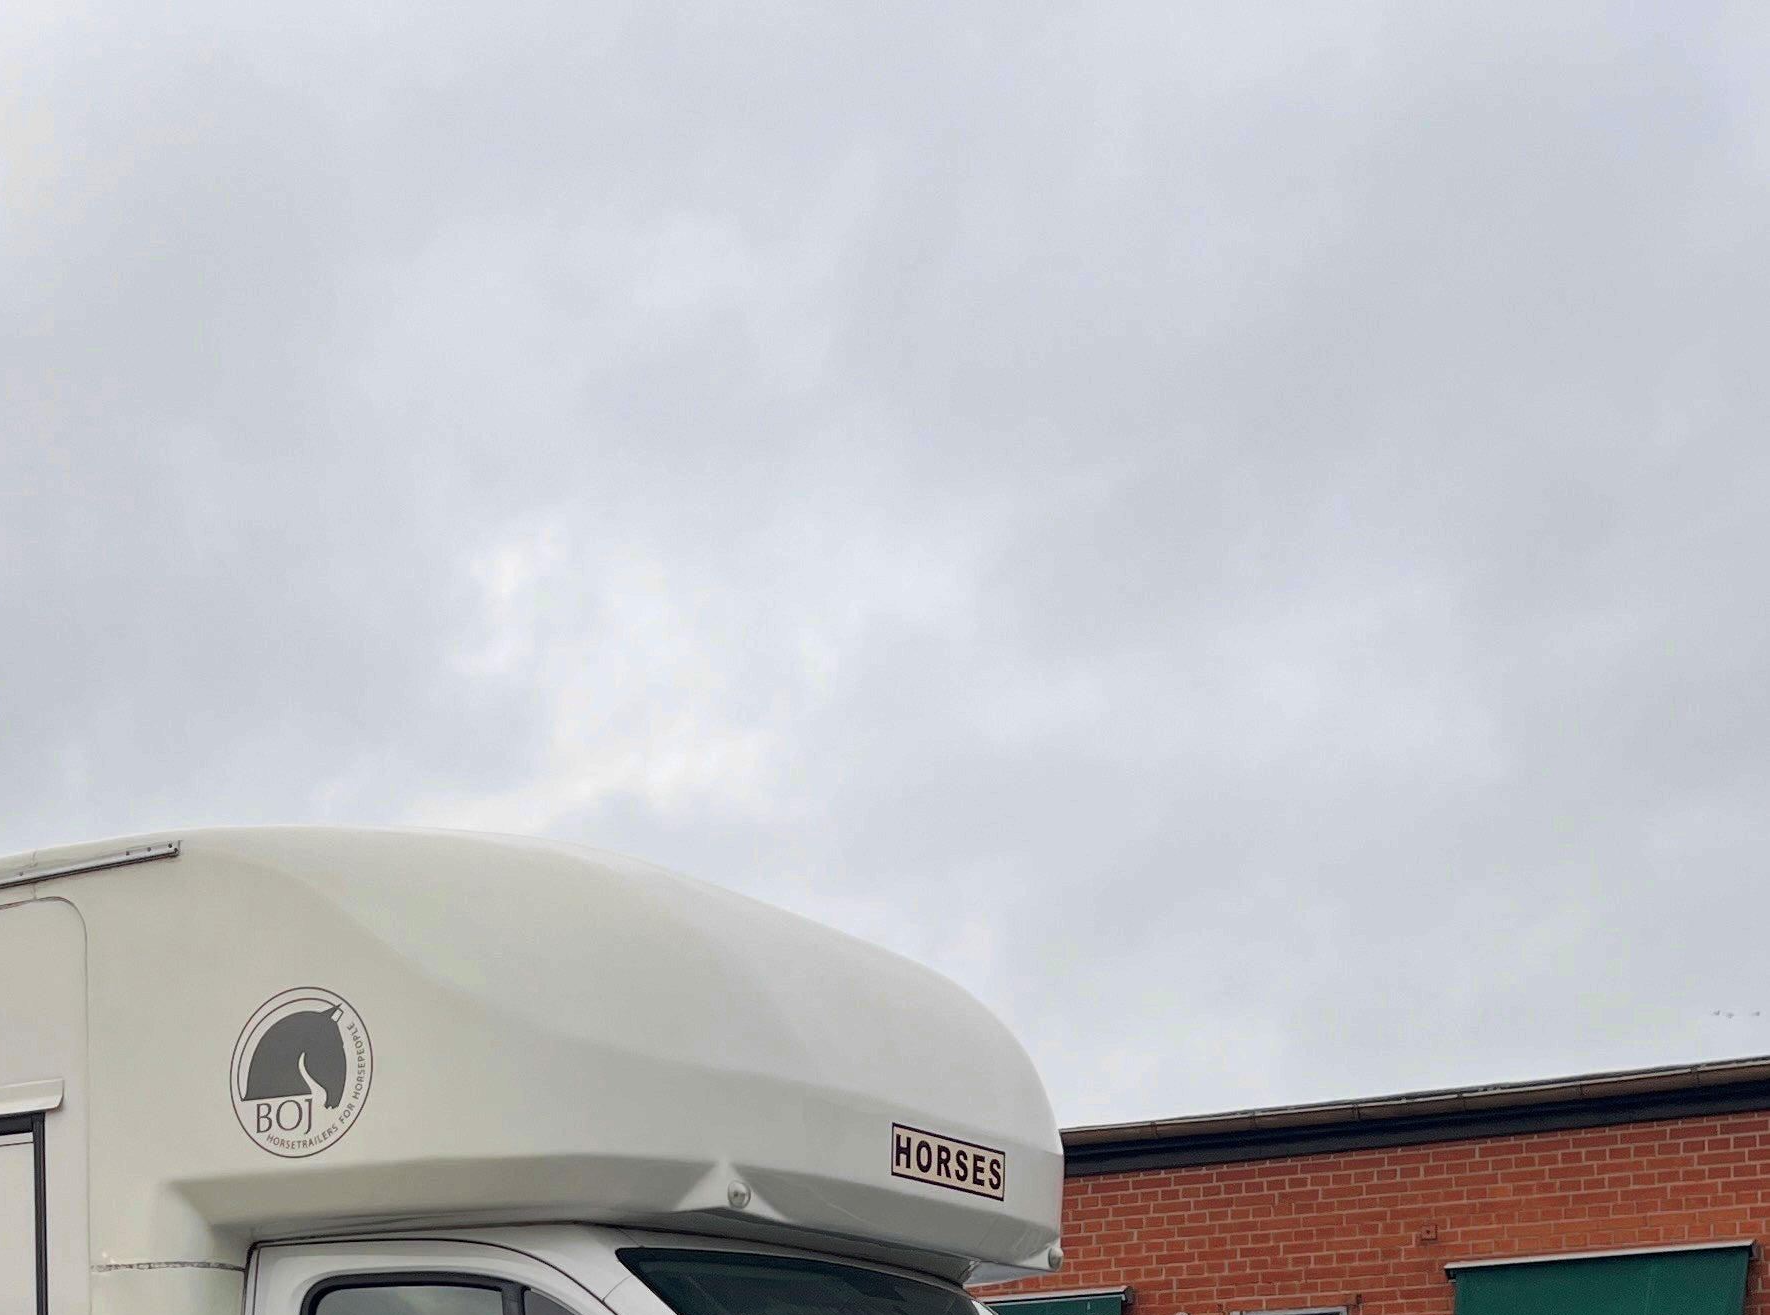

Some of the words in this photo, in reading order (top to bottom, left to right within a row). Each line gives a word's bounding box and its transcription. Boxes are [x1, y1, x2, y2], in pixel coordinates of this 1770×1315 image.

[346, 1021, 366, 1100] HORSEPEOPLE
[256, 1098, 314, 1135] BOJ
[338, 1103, 356, 1125] FOR
[265, 1124, 339, 1150] HORSETRAILERS
[895, 1133, 1002, 1190] HORSES
